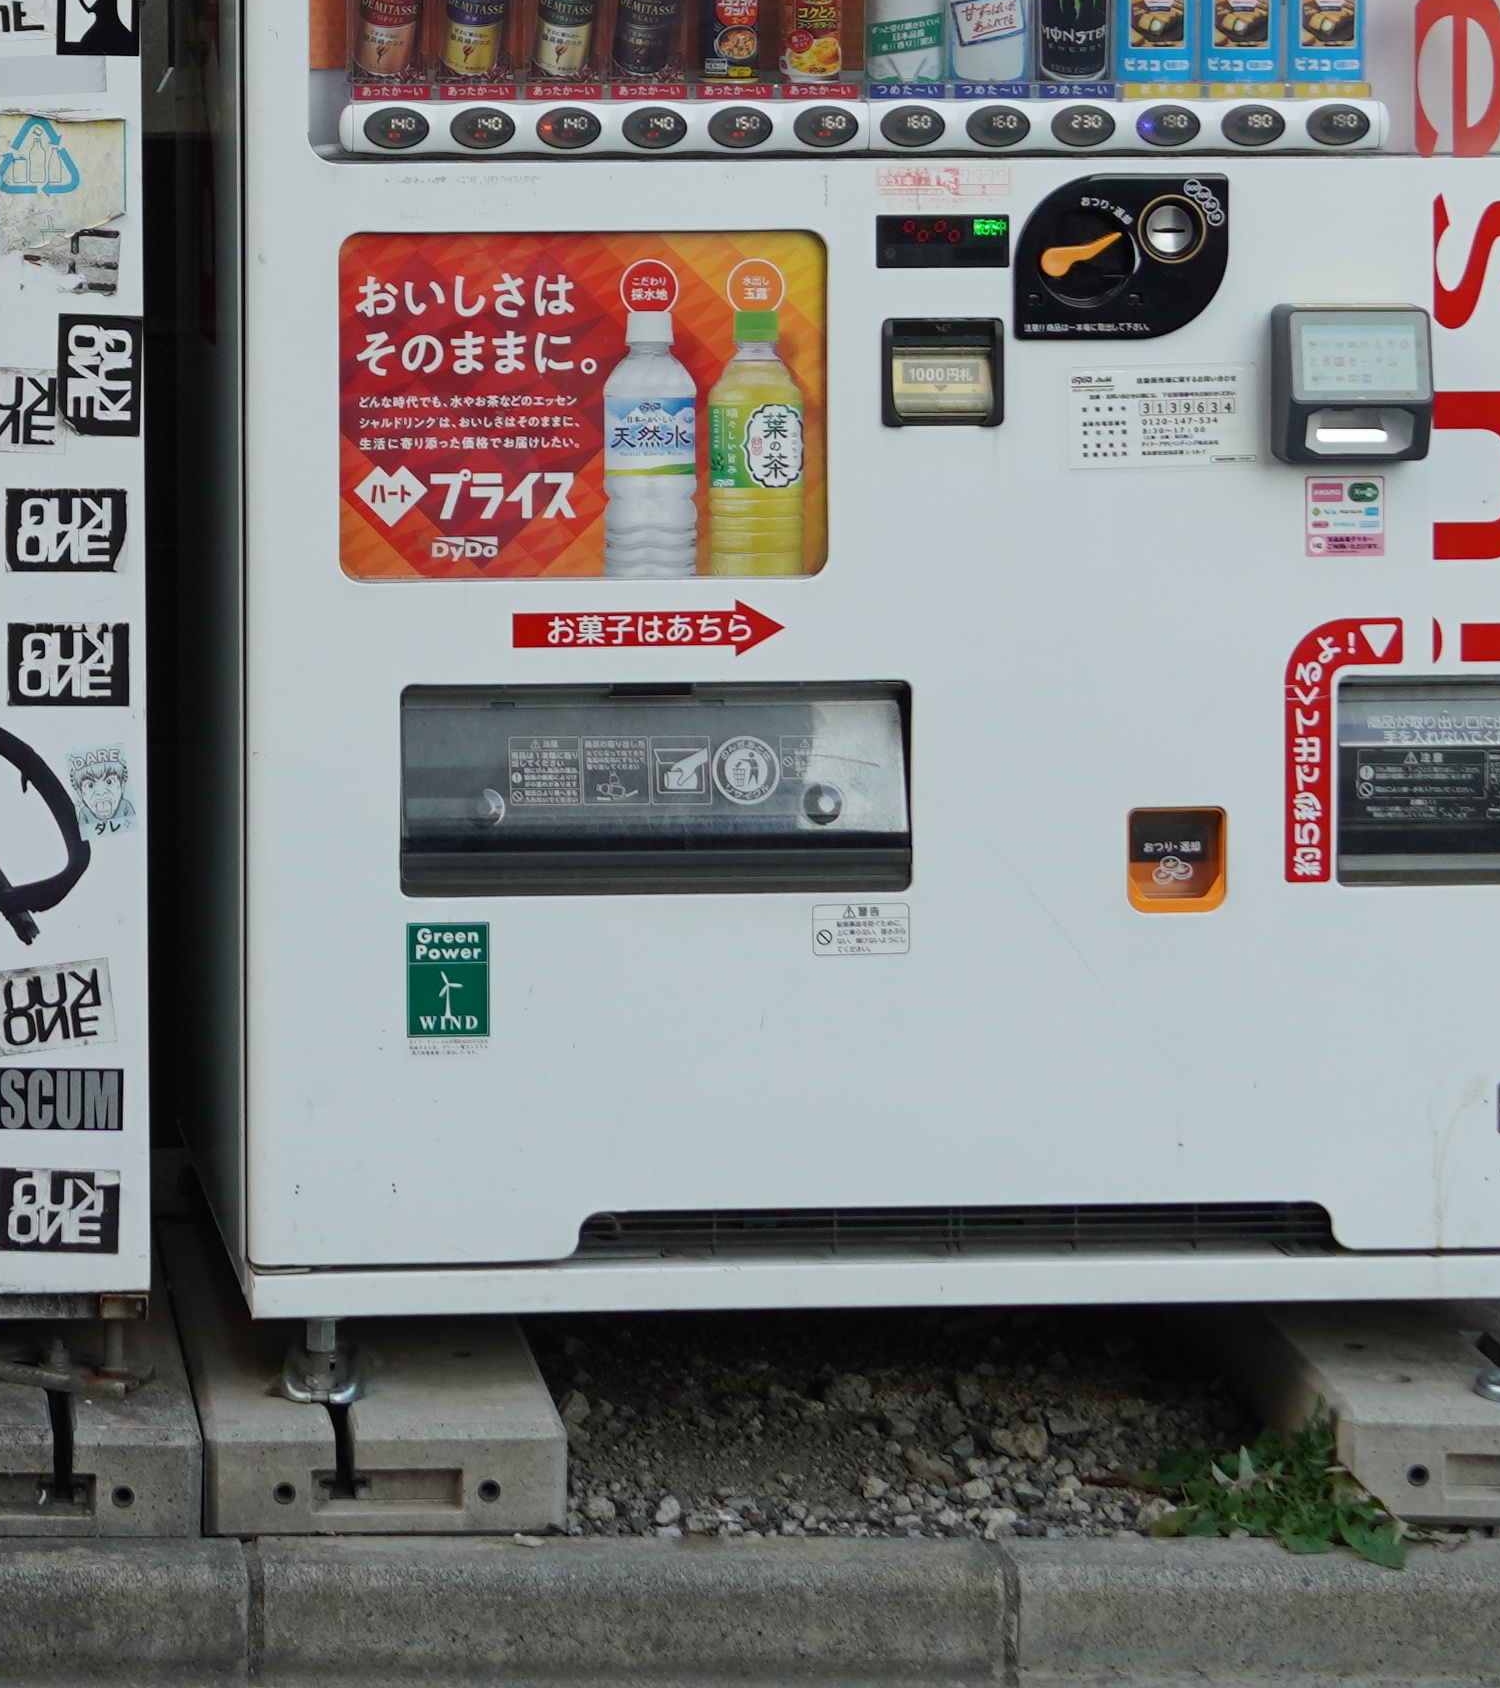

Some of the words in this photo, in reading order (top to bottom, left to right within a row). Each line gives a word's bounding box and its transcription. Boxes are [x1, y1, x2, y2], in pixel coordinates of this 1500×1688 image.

[1123, 57, 1159, 72] ビスコ
[355, 273, 575, 318] おいしさは
[355, 331, 597, 376] そのままに。
[907, 367, 974, 382] 1000円札
[1142, 401, 1233, 415] 3139634
[610, 425, 692, 449] 天然水
[762, 412, 790, 479] 葉の茶
[370, 484, 412, 503] ハート
[430, 468, 577, 520] プライス
[431, 536, 499, 562] DyDo
[546, 614, 753, 645] お菓子はあちら
[416, 927, 479, 945] Green
[415, 944, 482, 963] Power
[418, 1013, 479, 1032] WIND
[0, 1070, 121, 1129] SCUM
